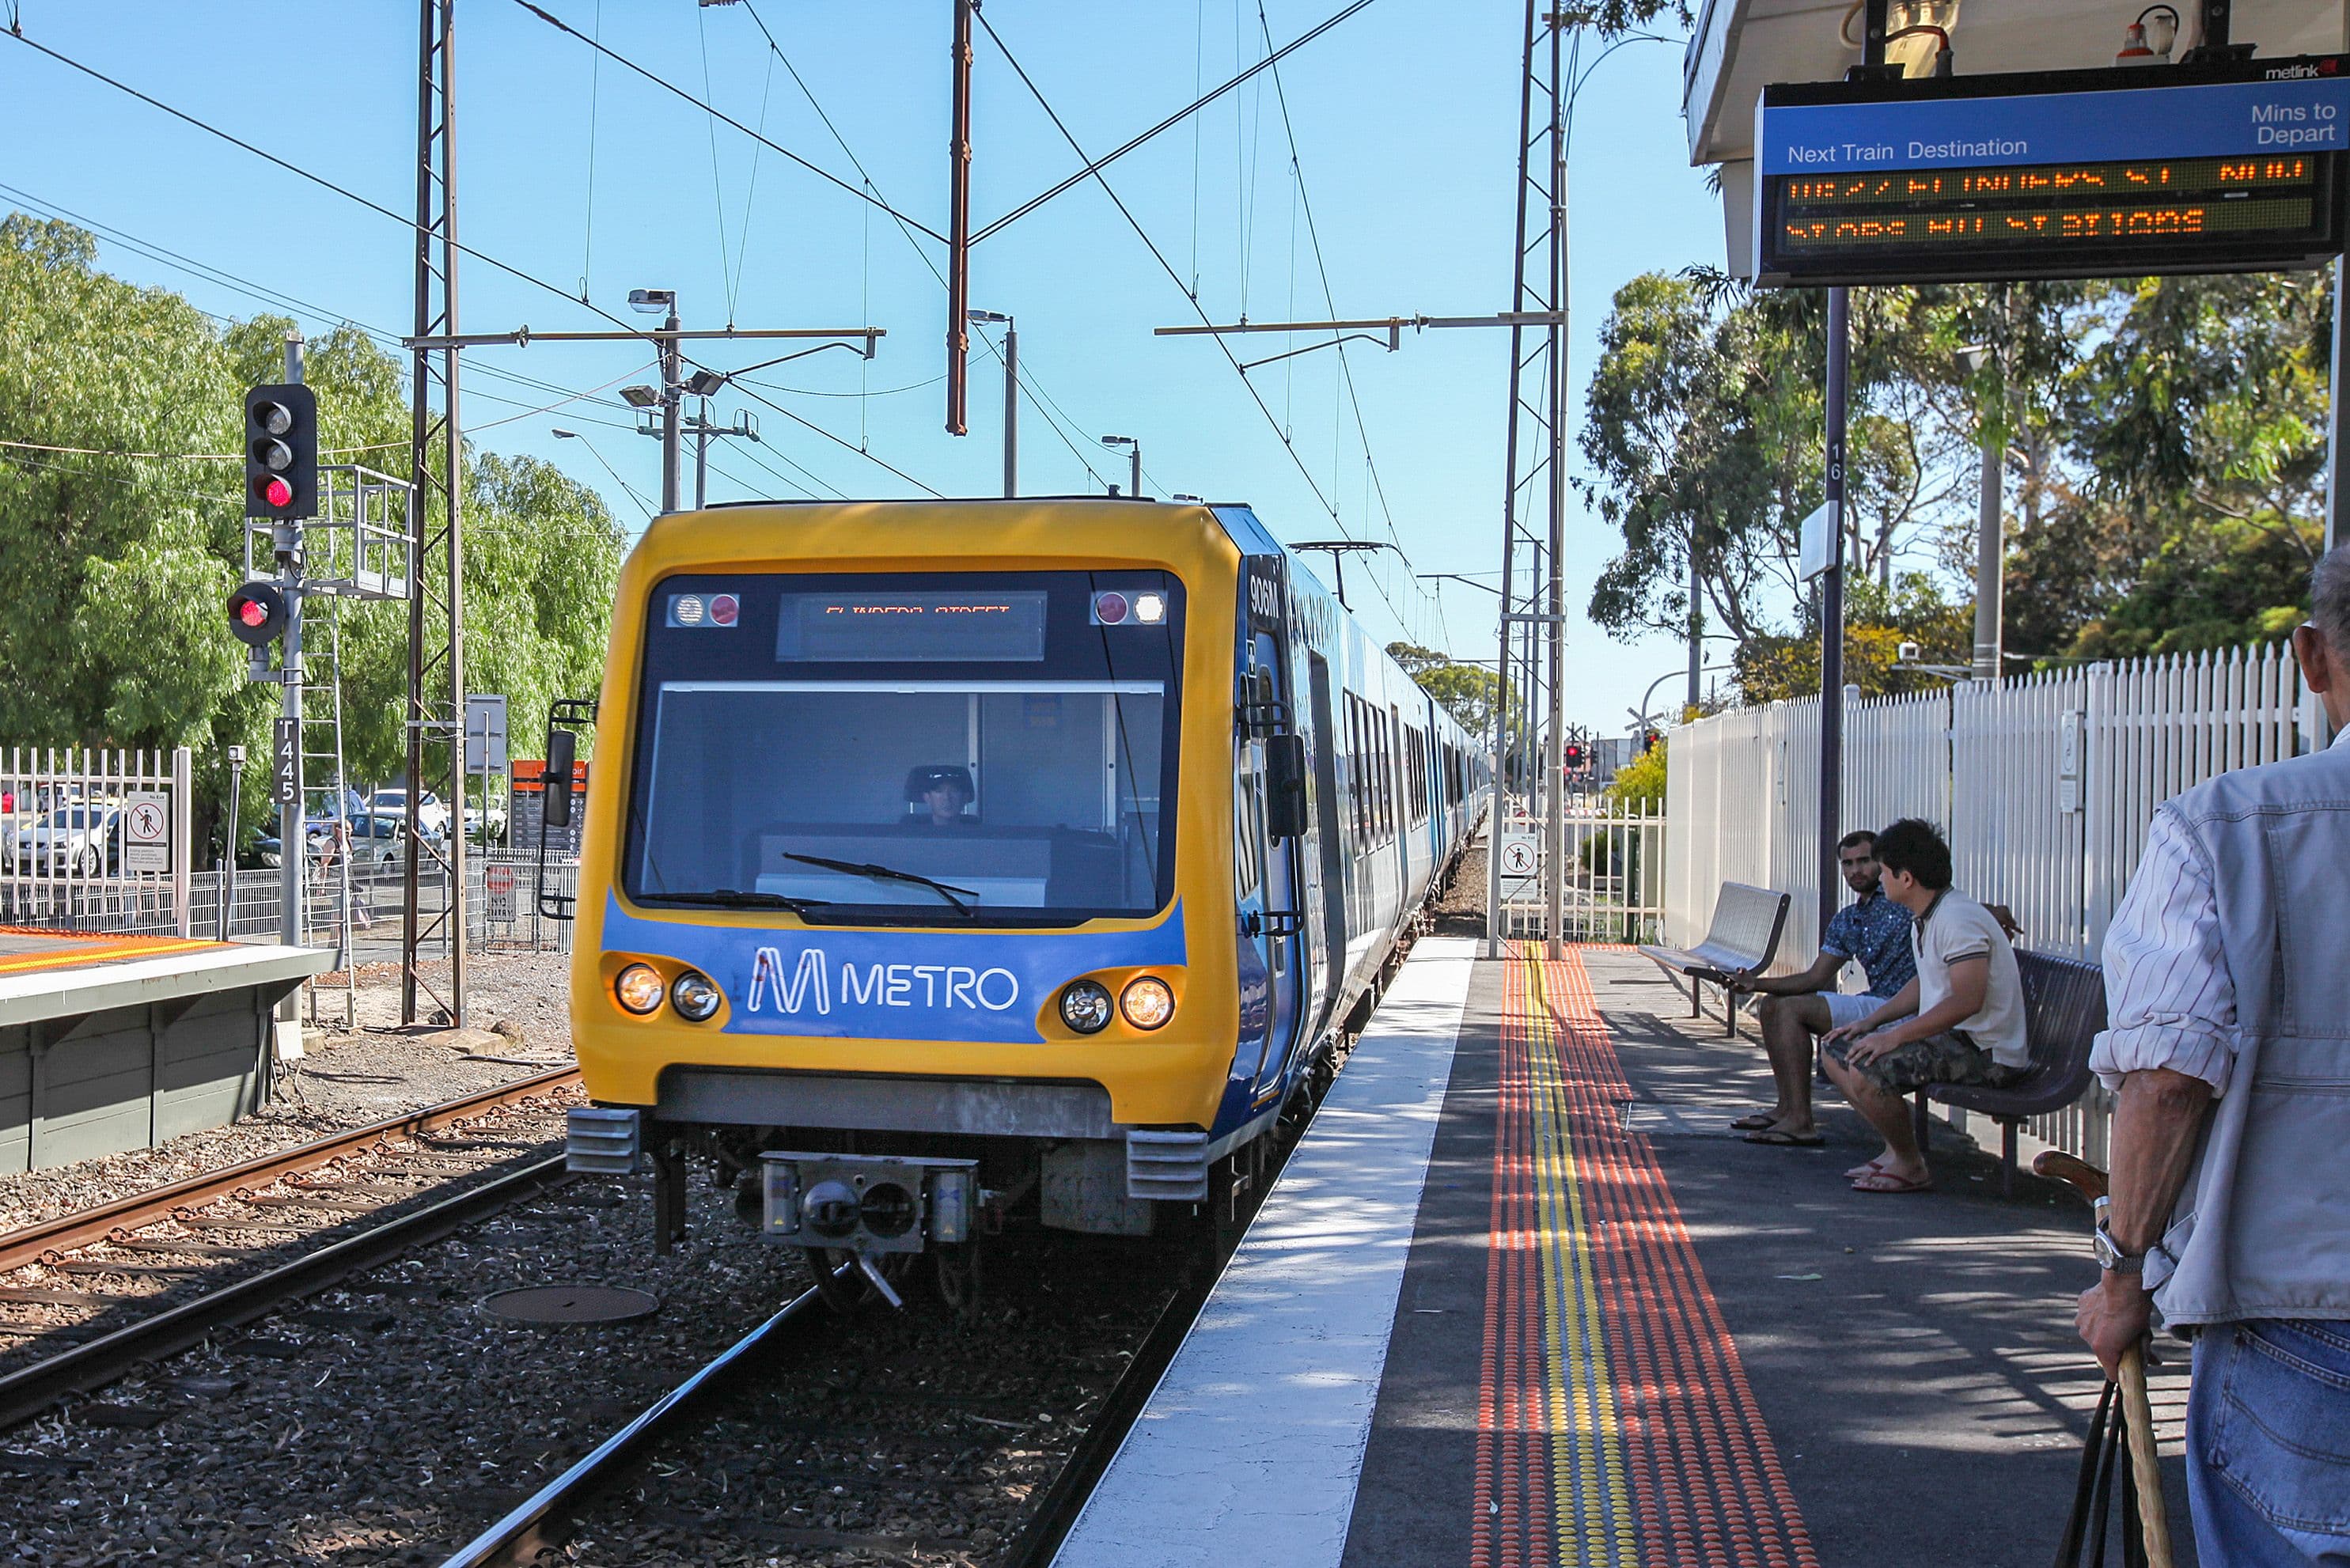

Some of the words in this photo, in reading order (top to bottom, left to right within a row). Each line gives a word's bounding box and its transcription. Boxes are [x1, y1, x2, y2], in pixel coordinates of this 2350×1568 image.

[2266, 64, 2318, 80] metlink
[2252, 104, 2306, 123] Mins
[2314, 103, 2337, 120] to
[2258, 124, 2336, 148] Depart
[1788, 146, 1836, 163] Next
[1842, 143, 1893, 161] Train
[1908, 138, 2027, 159] Destination
[1250, 574, 1279, 619] 906M
[280, 720, 294, 801] T445
[491, 896, 506, 907] NO
[841, 962, 1019, 1011] METRO
